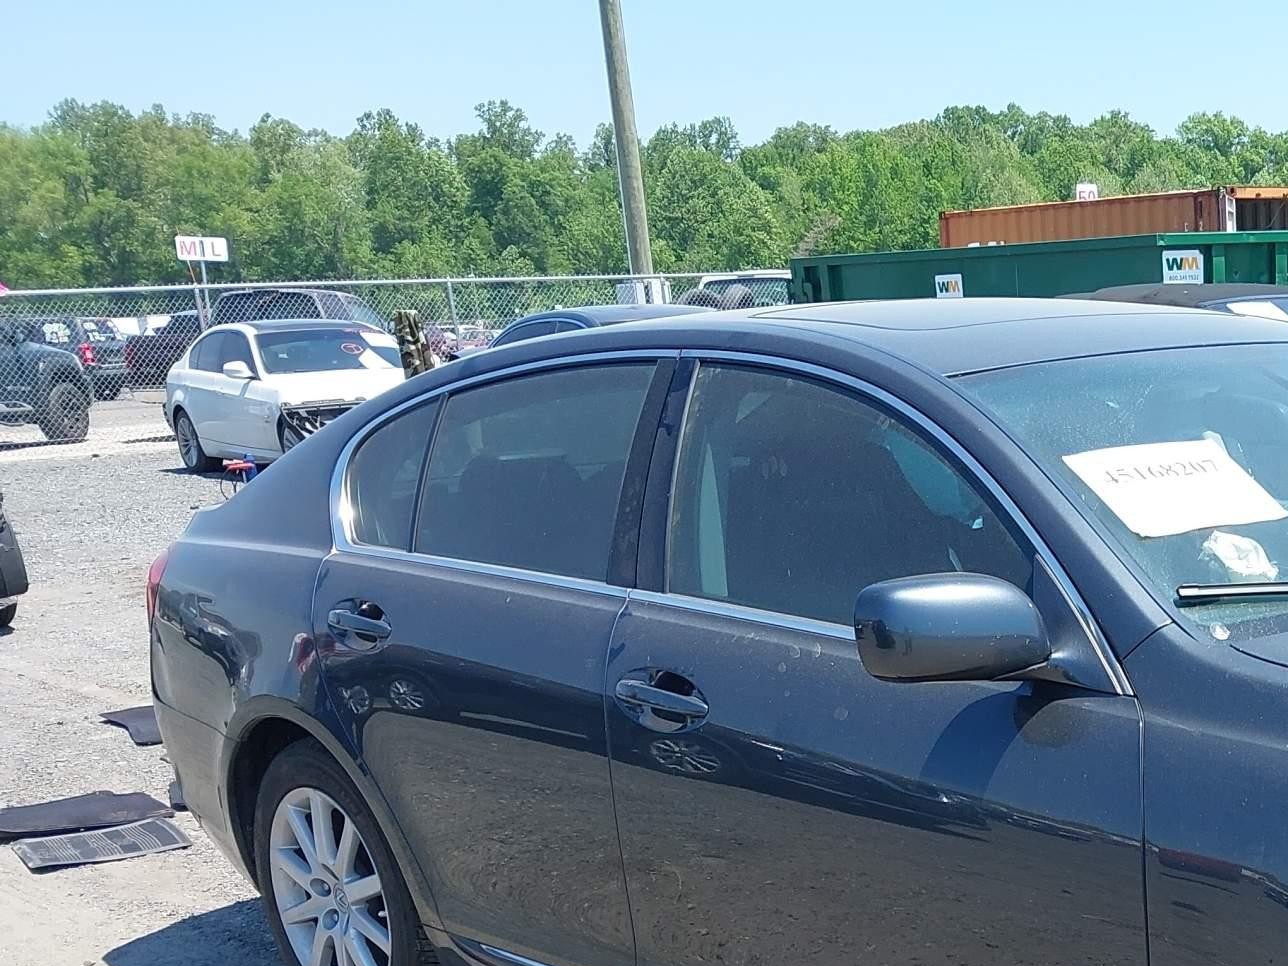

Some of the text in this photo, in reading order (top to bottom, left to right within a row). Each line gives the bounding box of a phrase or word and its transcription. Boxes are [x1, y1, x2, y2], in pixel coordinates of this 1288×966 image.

[179, 239, 222, 257] MIL
[1166, 256, 1199, 271] WM
[937, 280, 960, 293] WM
[1104, 459, 1219, 483] 45168207
